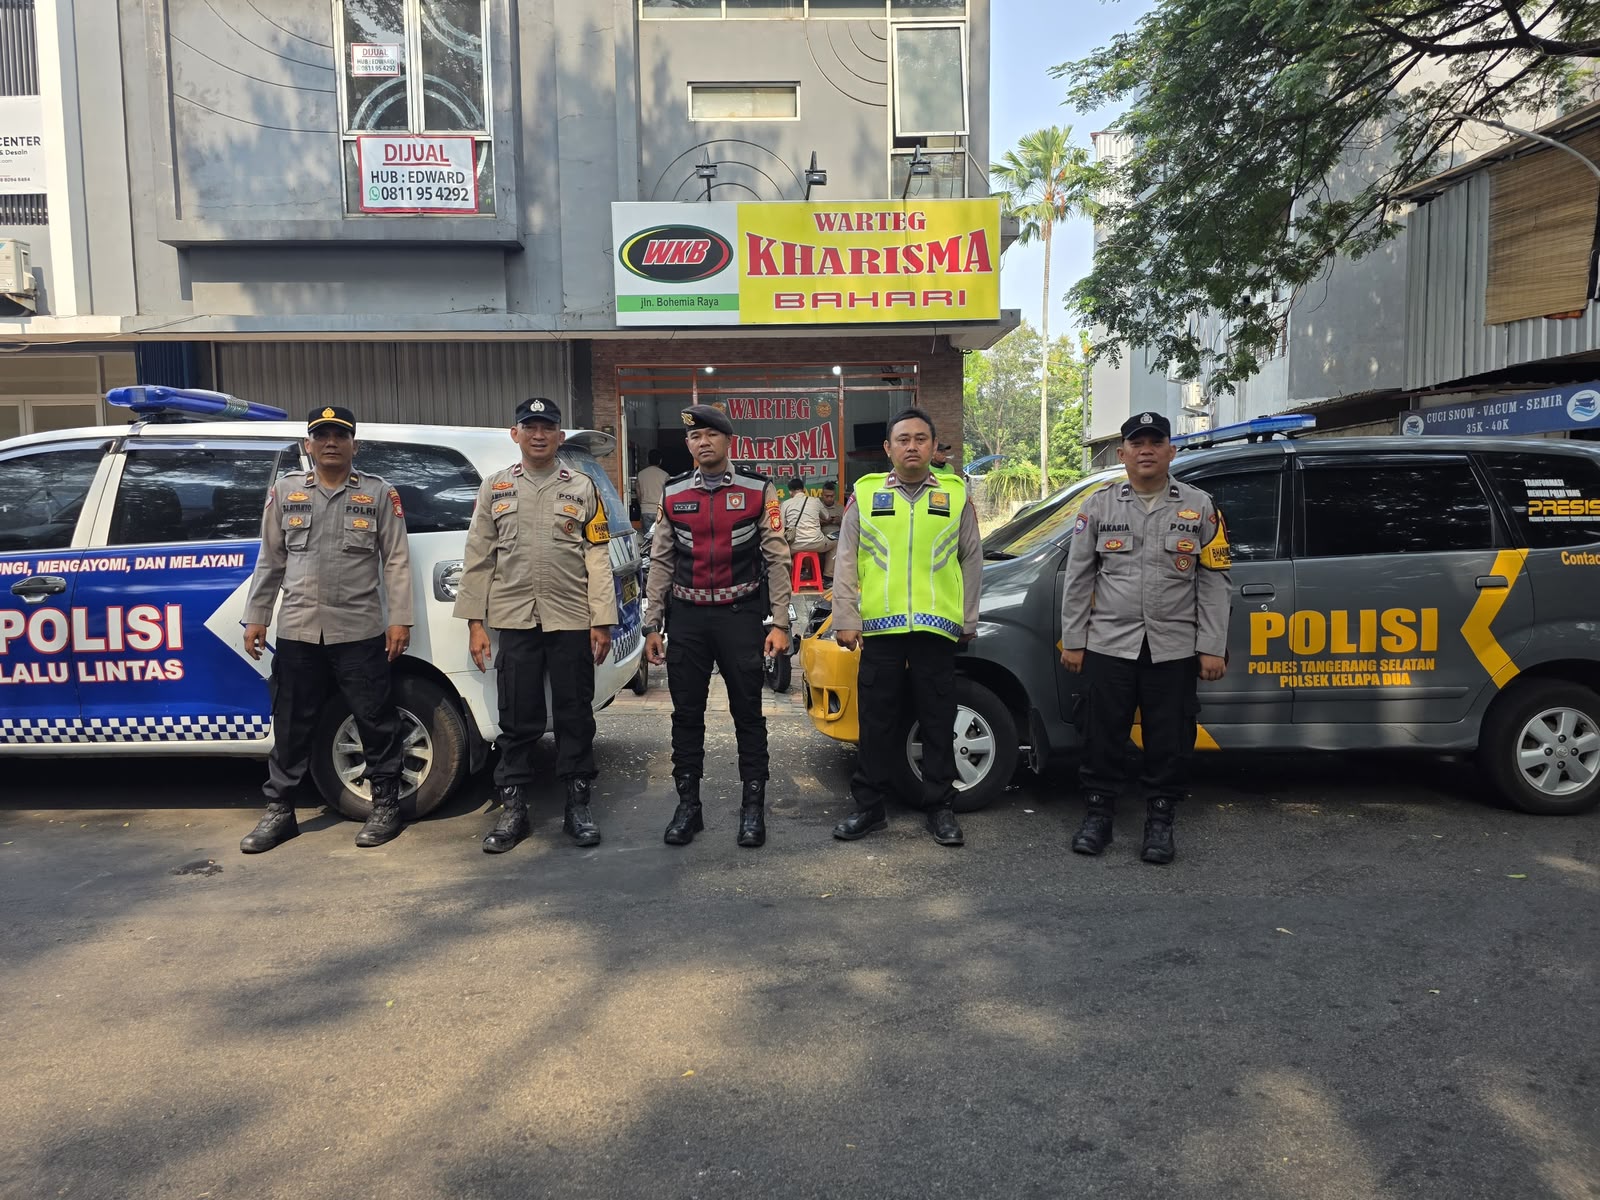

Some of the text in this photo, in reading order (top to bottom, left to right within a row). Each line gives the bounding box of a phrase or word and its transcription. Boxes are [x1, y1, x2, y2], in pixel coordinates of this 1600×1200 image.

[362, 48, 389, 56] DIJUAL
[384, 143, 450, 162] DIJUAL
[371, 171, 398, 184] HUB
[408, 171, 465, 184] EDWARD
[381, 186, 469, 202] 0811 95 4292
[813, 211, 927, 233] WARTEG
[642, 238, 711, 265] WKB
[745, 228, 993, 276] KHARISMA
[640, 296, 719, 310] jln. Bohemia Raya
[773, 289, 967, 310] BAHARI
[727, 398, 811, 420] WARTEG
[1426, 412, 1447, 424] CUCI
[1448, 407, 1475, 421] SNOW
[1483, 401, 1517, 416] VACUM
[1526, 394, 1563, 411] SEMIR
[1466, 423, 1483, 434] 35K
[1491, 418, 1509, 431] 40K
[726, 421, 837, 461] HARISMA
[750, 465, 829, 477] HARI
[558, 493, 584, 505] POLRI
[776, 488, 823, 498] 4 AM
[345, 505, 376, 516] POLRI
[1528, 499, 1600, 515] PRESIS
[36, 557, 131, 574] MENGAYOMI,
[134, 556, 166, 571] DAN
[169, 554, 245, 569] MELAYANI
[0, 604, 183, 655] POLISI
[1249, 608, 1438, 656] POLISI
[78, 658, 185, 682] LINTAS
[1248, 658, 1435, 674] POLRES TANGERANG SELATAN
[1279, 673, 1411, 688] POLSEK KELAPA DUA
